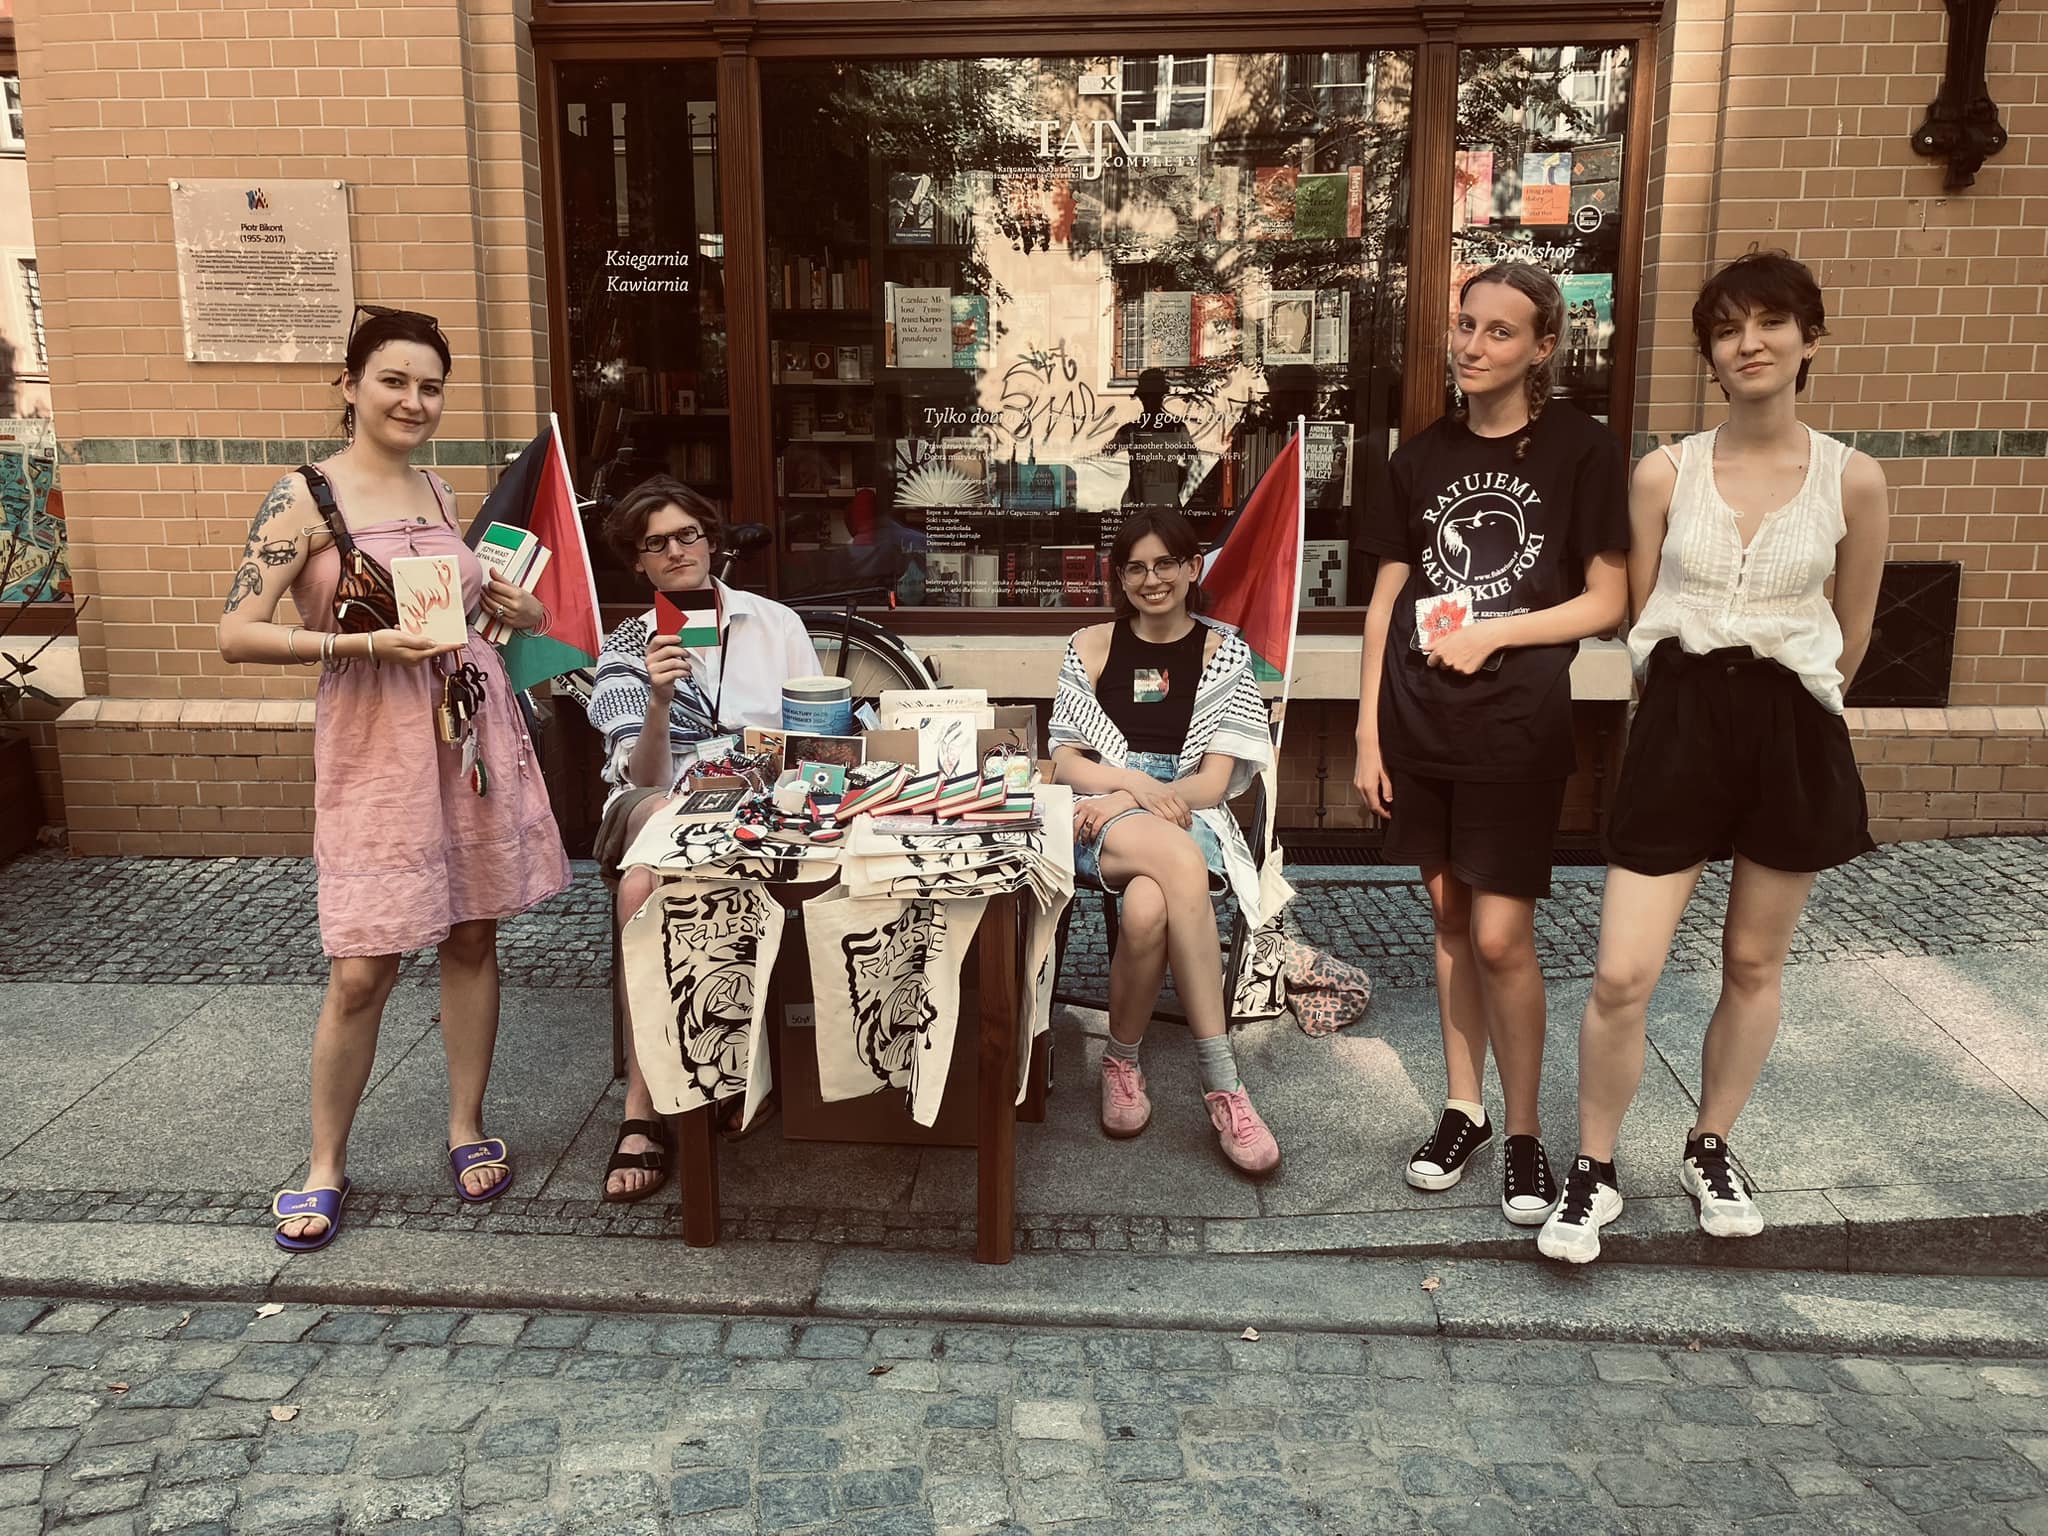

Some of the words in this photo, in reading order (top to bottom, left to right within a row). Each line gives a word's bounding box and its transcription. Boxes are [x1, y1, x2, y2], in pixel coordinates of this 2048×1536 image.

[1031, 119, 1161, 180] TAJNE
[1103, 156, 1198, 168] KOMPLETY
[241, 223, 258, 232] Piotr
[259, 223, 283, 232] Bikont
[605, 250, 689, 271] Księgarnia
[1495, 241, 1576, 263] Bookshop
[606, 275, 689, 292] Kawiarnia
[924, 407, 967, 428] Tylko
[1134, 440, 1163, 450] another
[1306, 444, 1333, 453] POLSKA
[1135, 451, 1166, 462] English,
[1167, 451, 1187, 463] good
[1306, 461, 1332, 471] POLSKA
[1423, 472, 1541, 525] RATUJEMY
[1512, 532, 1545, 580] FOKI
